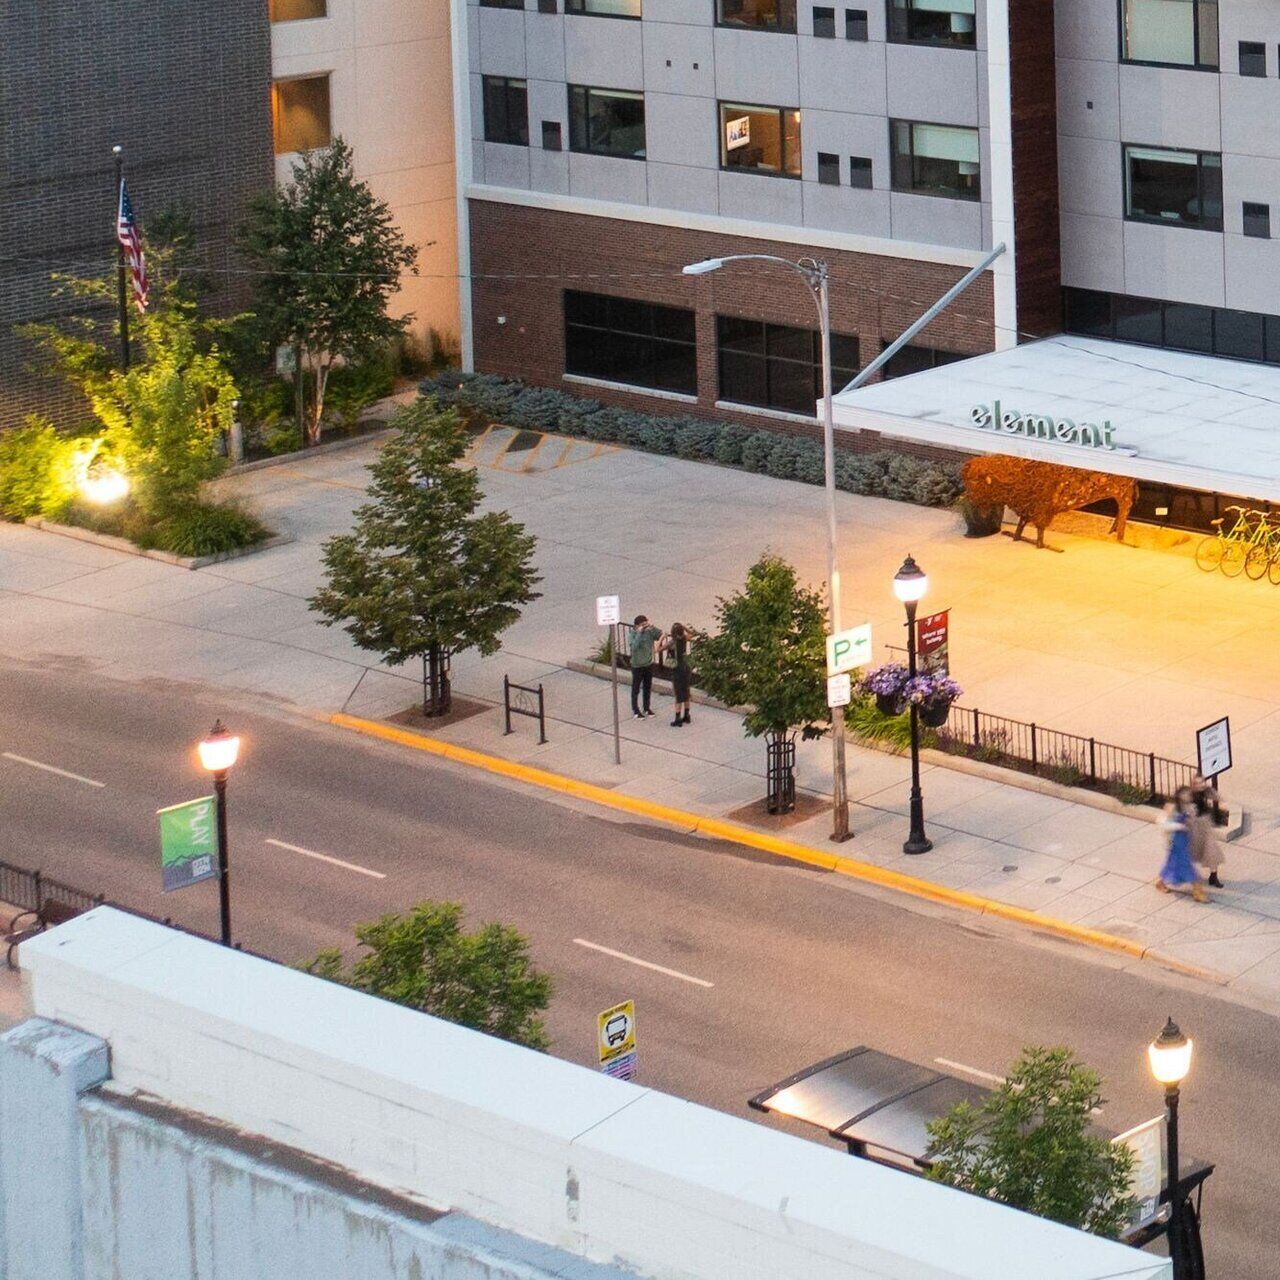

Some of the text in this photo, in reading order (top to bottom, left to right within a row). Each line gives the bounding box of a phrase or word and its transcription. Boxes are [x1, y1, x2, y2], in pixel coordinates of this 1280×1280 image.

[970, 399, 1117, 451] element
[834, 638, 851, 667] P
[190, 803, 210, 846] PLAY
